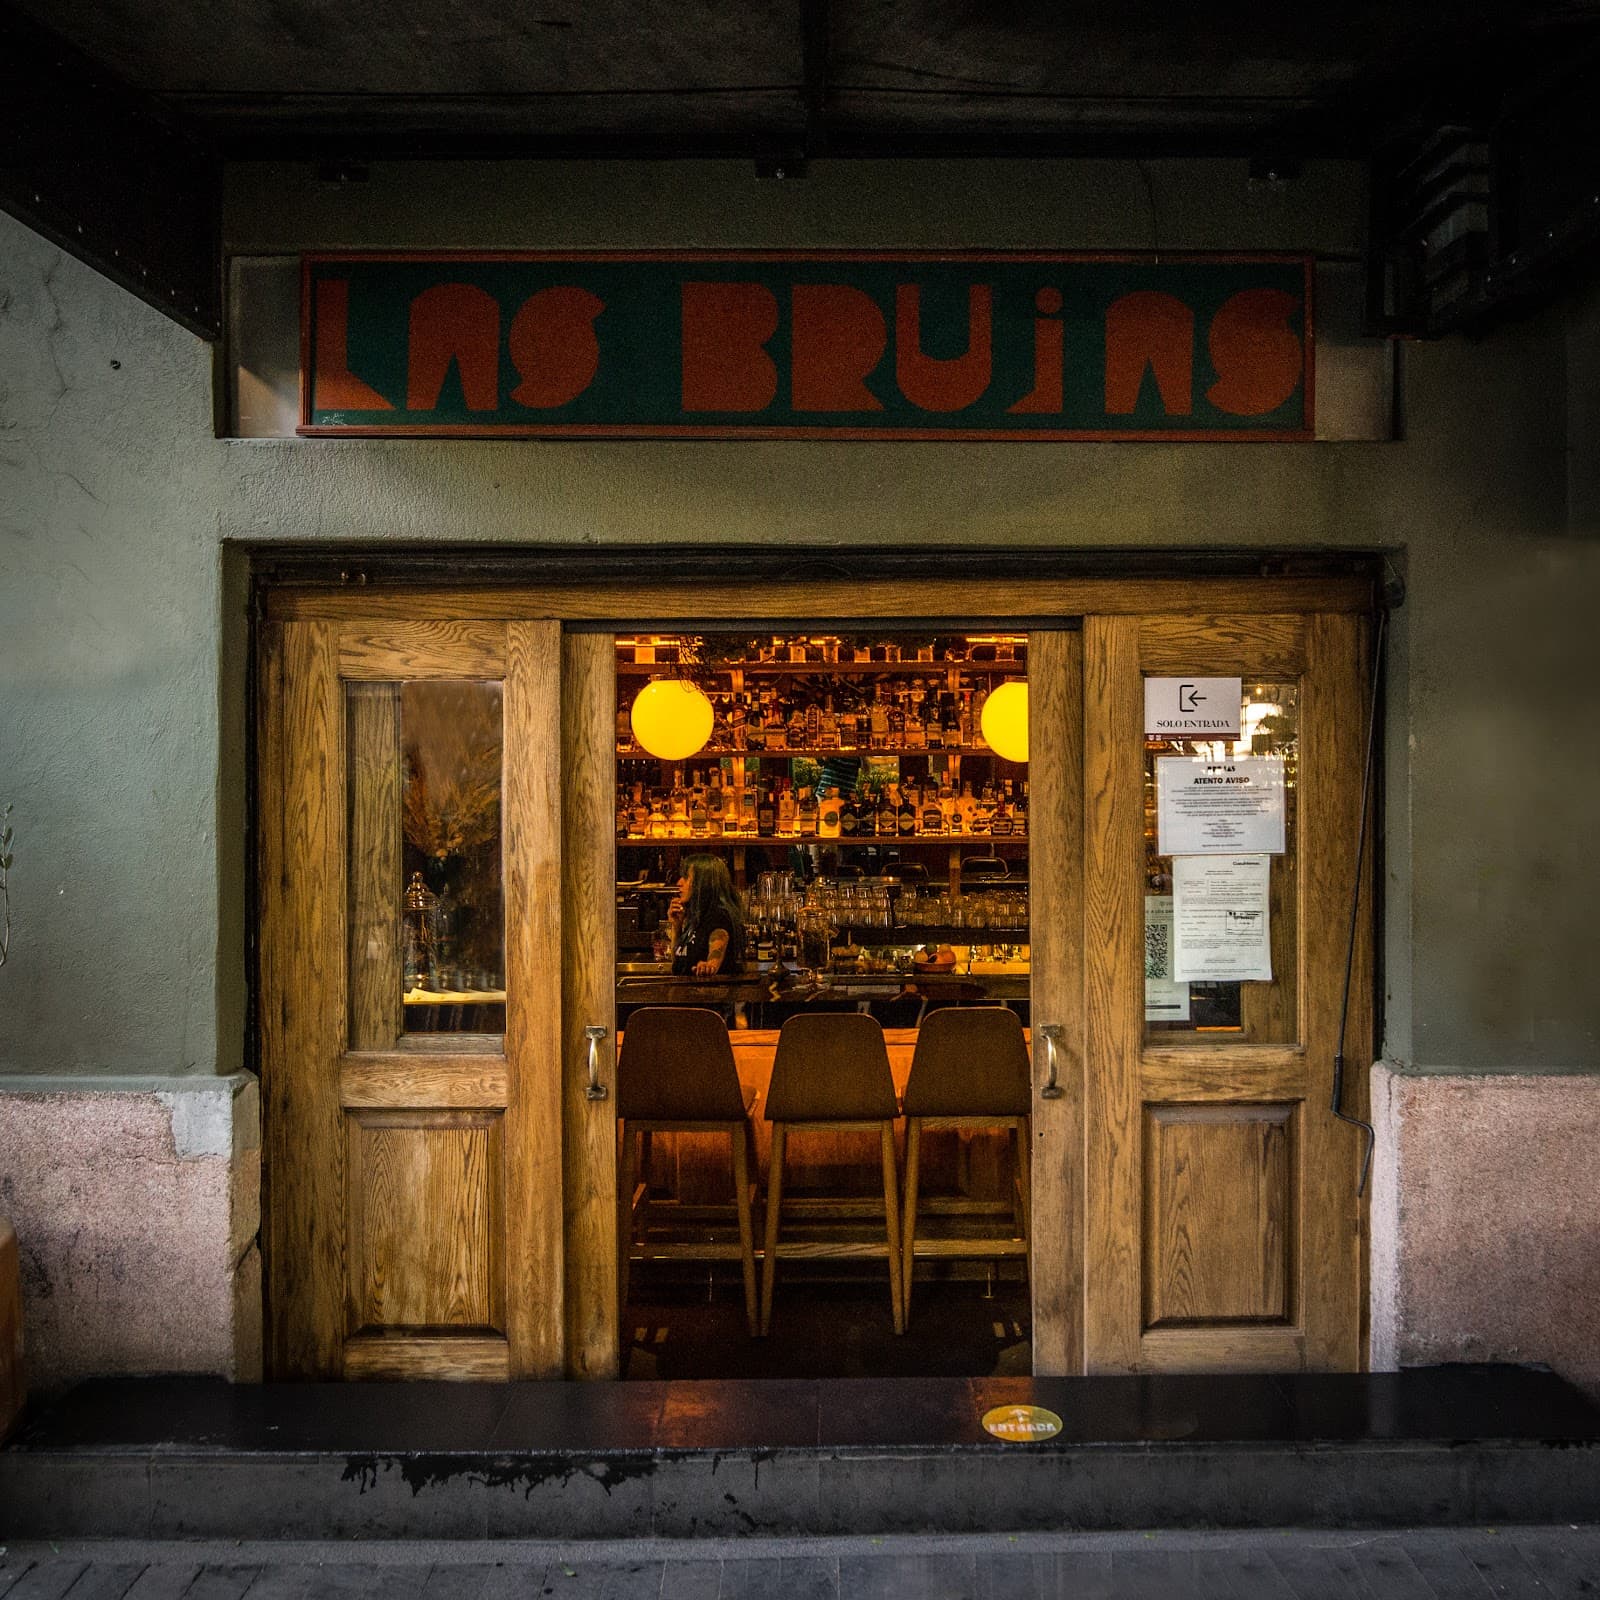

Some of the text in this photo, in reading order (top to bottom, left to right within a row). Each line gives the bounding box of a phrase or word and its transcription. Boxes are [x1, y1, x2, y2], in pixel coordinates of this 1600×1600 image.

[314, 279, 606, 410] LAS
[1156, 719, 1231, 728] SOLO ENTRADA
[1193, 776, 1250, 785] ATENTO AVISO
